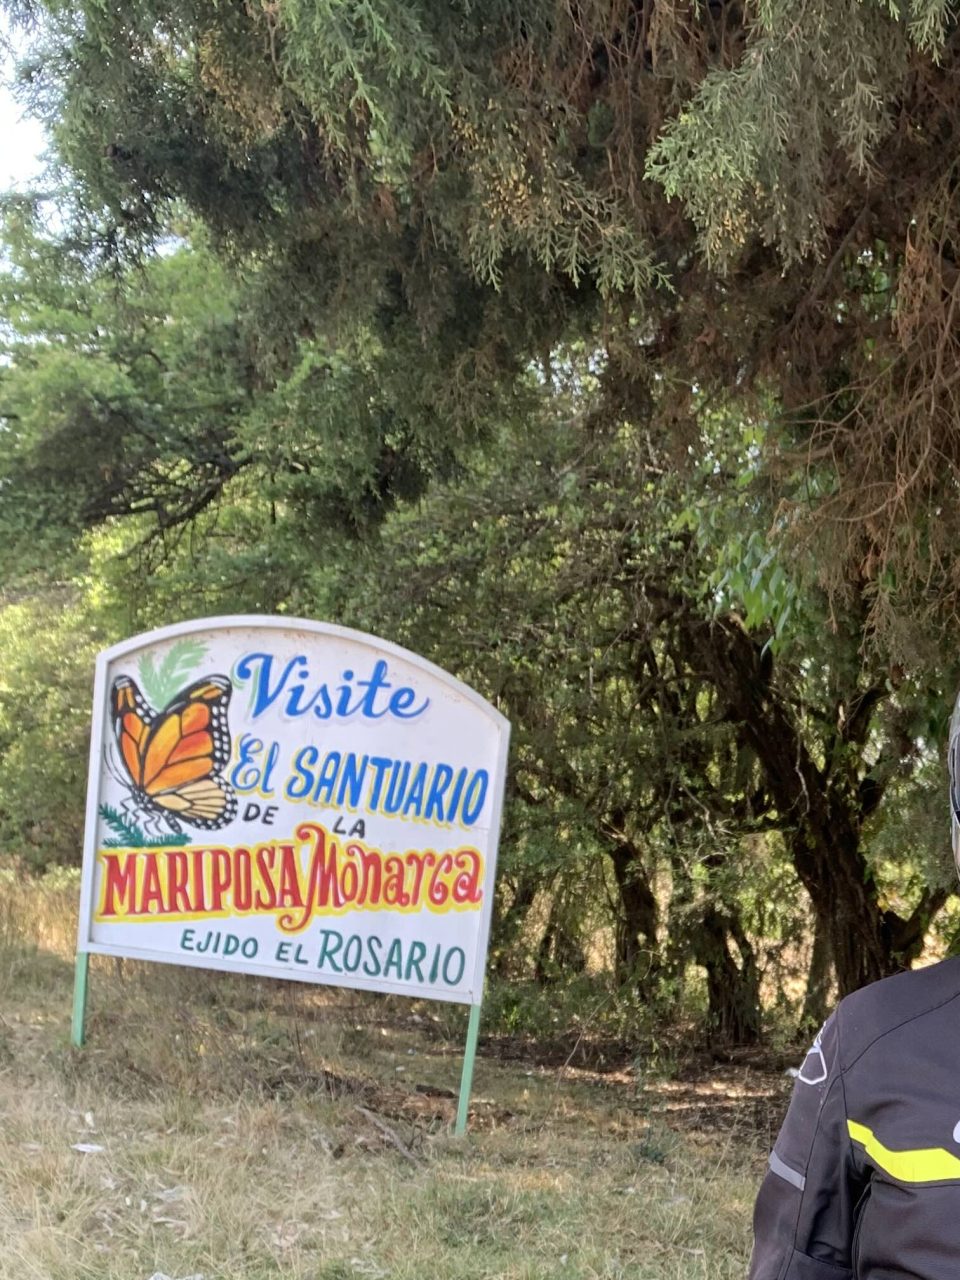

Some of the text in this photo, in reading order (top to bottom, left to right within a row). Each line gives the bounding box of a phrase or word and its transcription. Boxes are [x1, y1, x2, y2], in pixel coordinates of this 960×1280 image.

[236, 652, 430, 720] Visite
[231, 733, 489, 825] El SANTUARIO
[242, 801, 367, 839] DE LA
[100, 824, 483, 933] MARIPOSA Monarca
[180, 929, 466, 986] EJIDO EL ROSARIO
